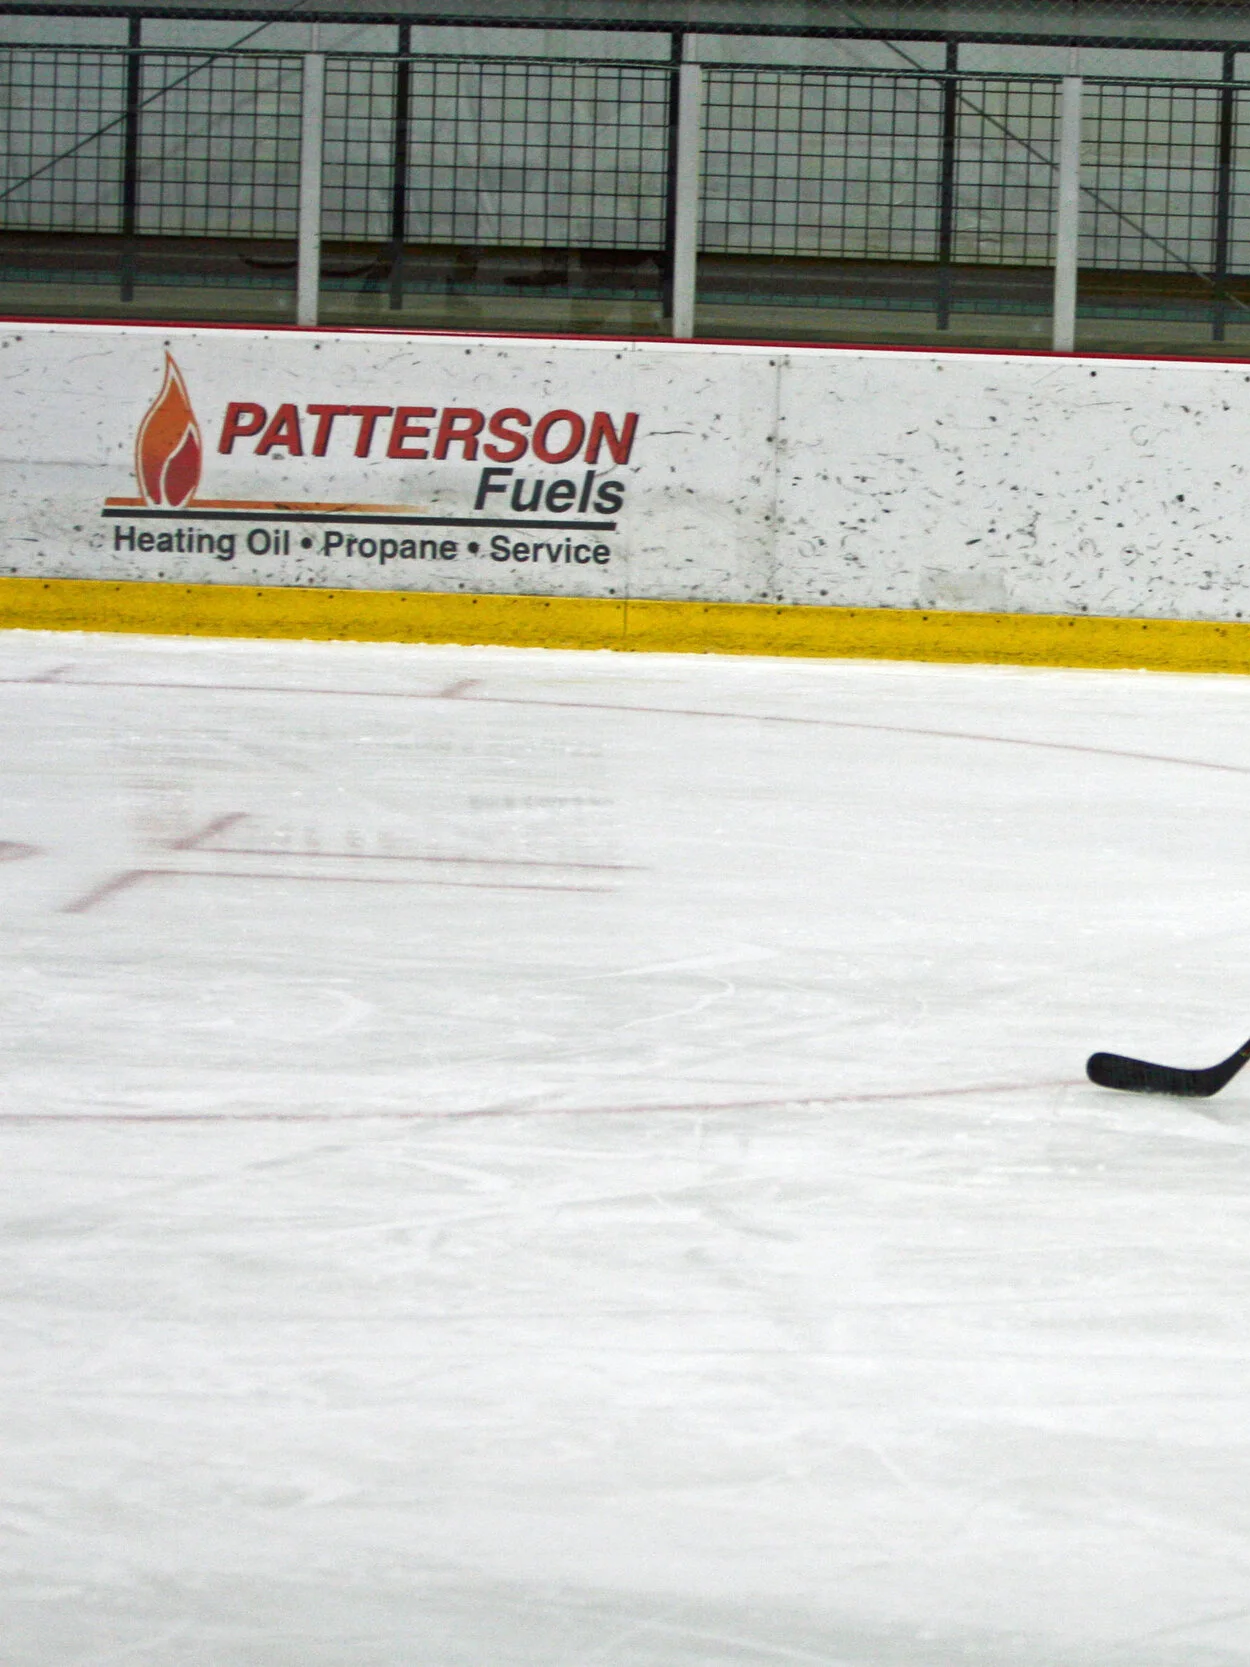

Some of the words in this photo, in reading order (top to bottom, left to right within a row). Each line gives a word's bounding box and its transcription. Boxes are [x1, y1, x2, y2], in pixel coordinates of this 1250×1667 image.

[218, 402, 638, 465] PATTERSON
[473, 467, 625, 514] Fuels
[113, 525, 236, 560] Heating
[246, 530, 290, 556] Oil
[323, 531, 457, 564] Propane
[490, 535, 611, 564] Service
